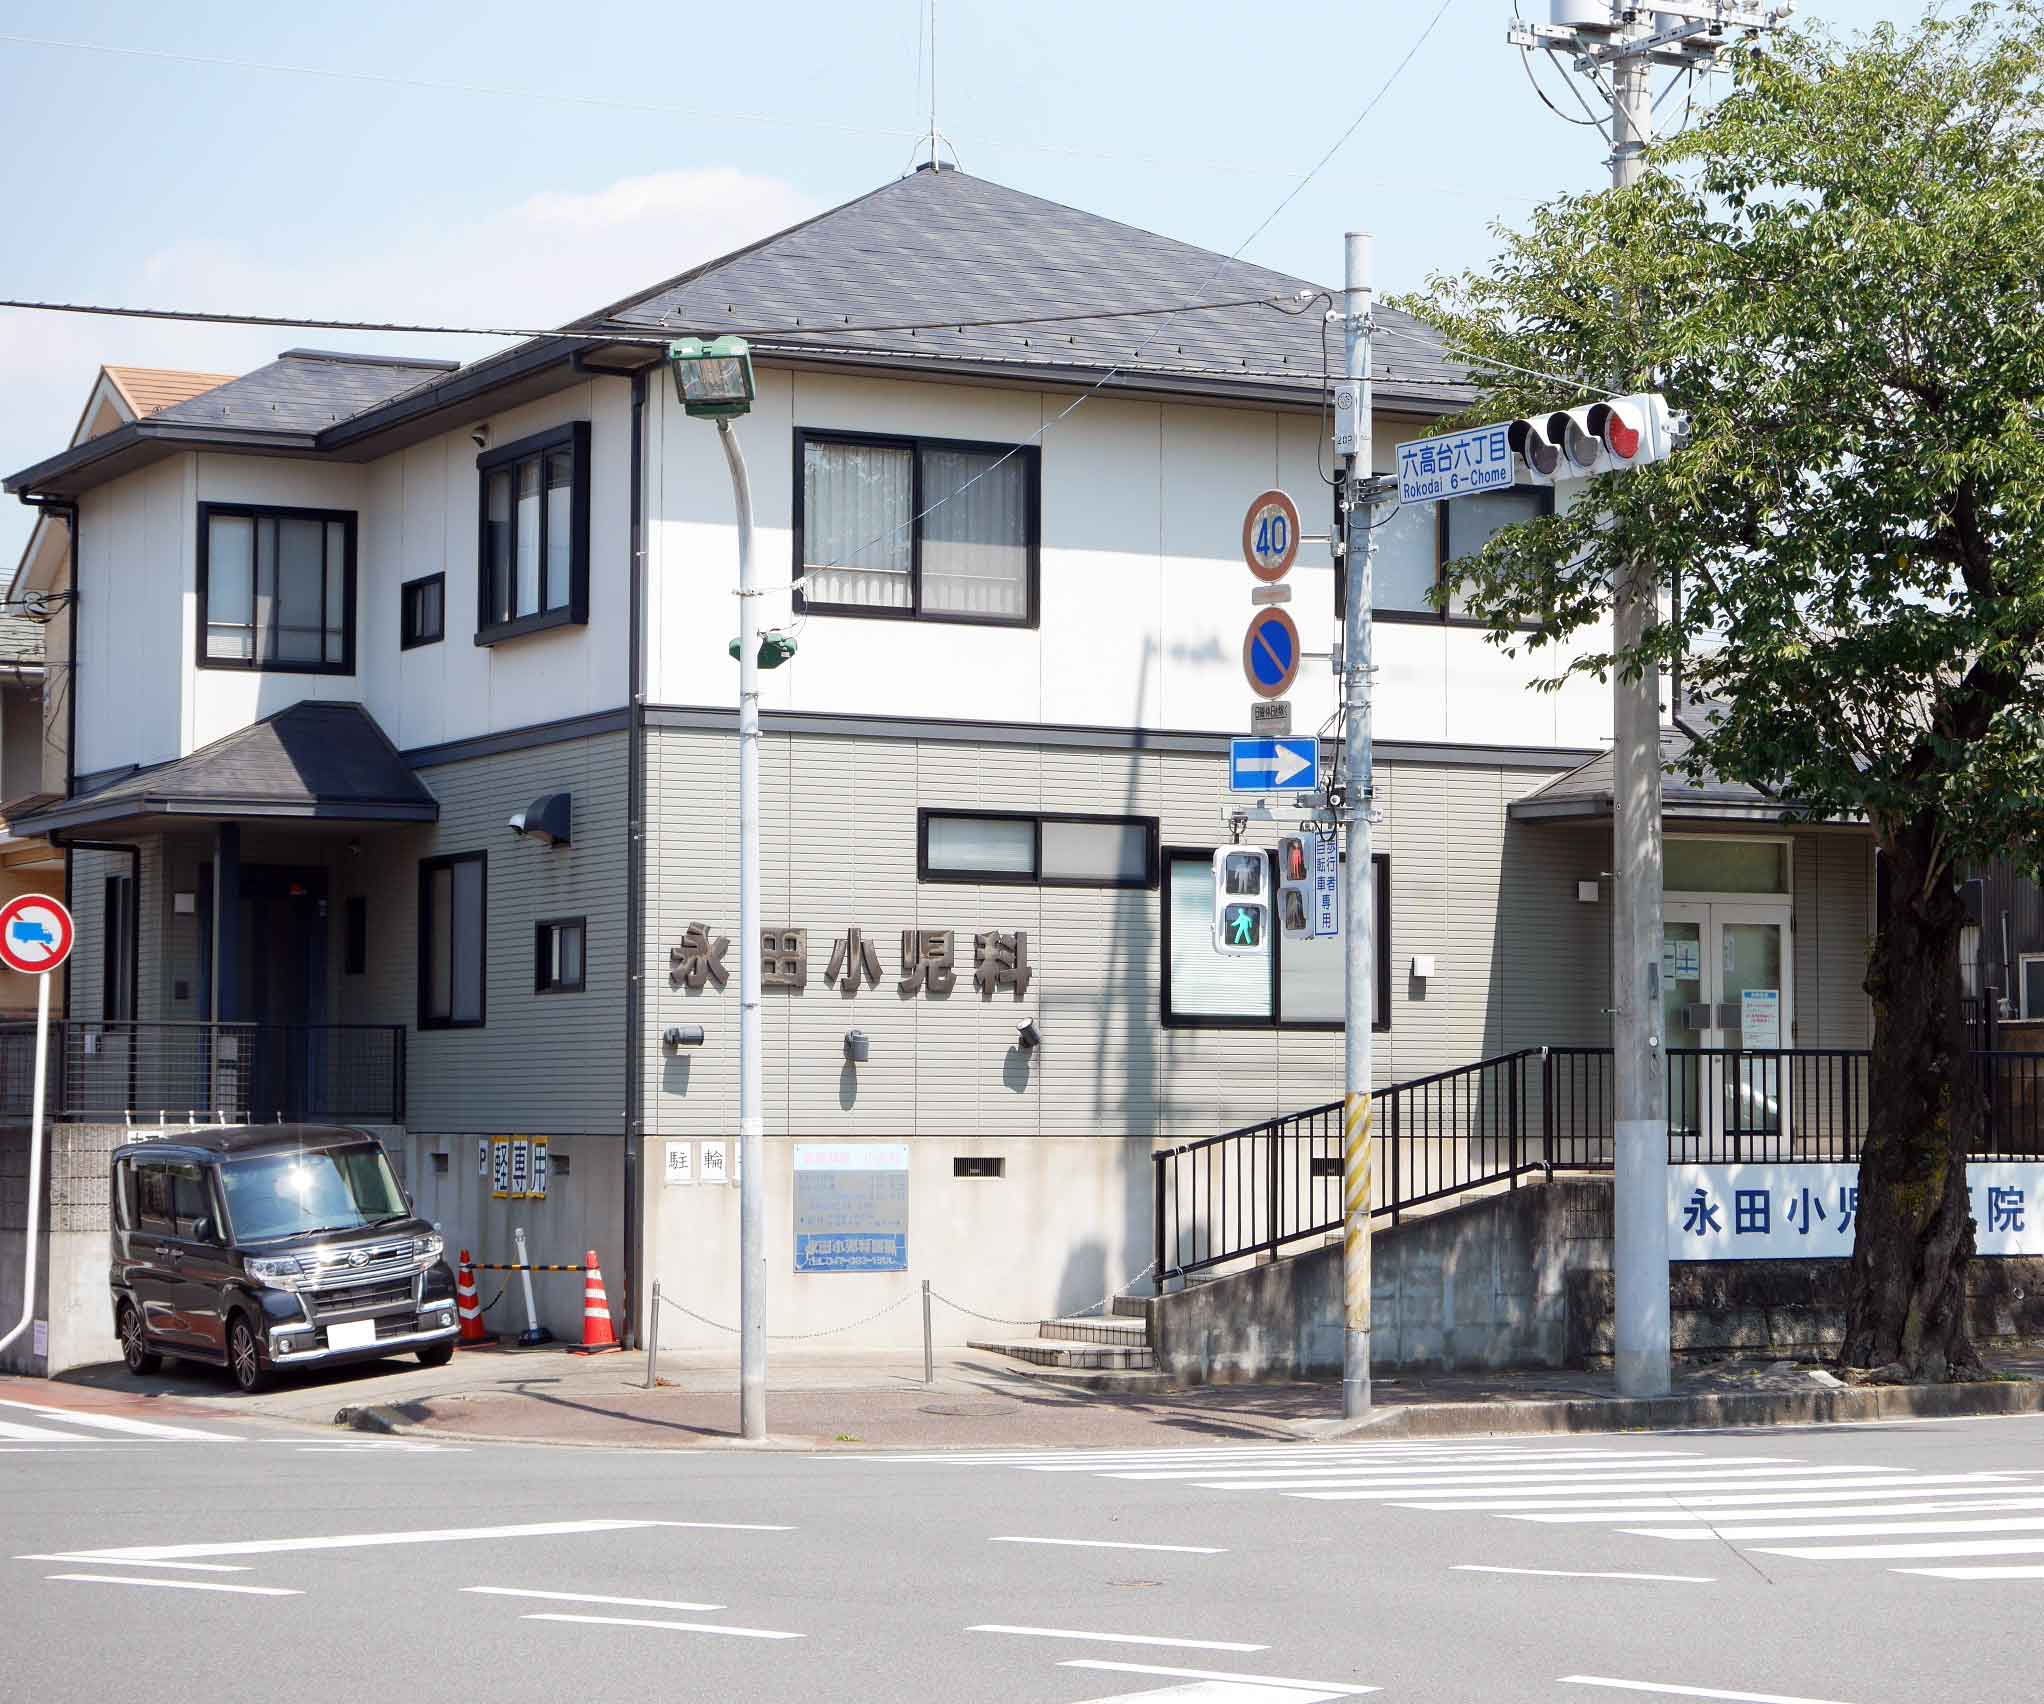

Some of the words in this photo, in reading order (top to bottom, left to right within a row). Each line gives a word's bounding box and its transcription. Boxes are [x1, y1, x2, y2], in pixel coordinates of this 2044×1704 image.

[1402, 431, 1506, 479] 六高台六丁目
[1404, 479, 1443, 498] Rokodai
[1450, 467, 1506, 489] 6-Chome
[1256, 515, 1286, 556] 40
[669, 921, 1033, 1001] 永田小児科
[480, 1148, 487, 1171] P
[669, 1148, 743, 1170] 駐輪
